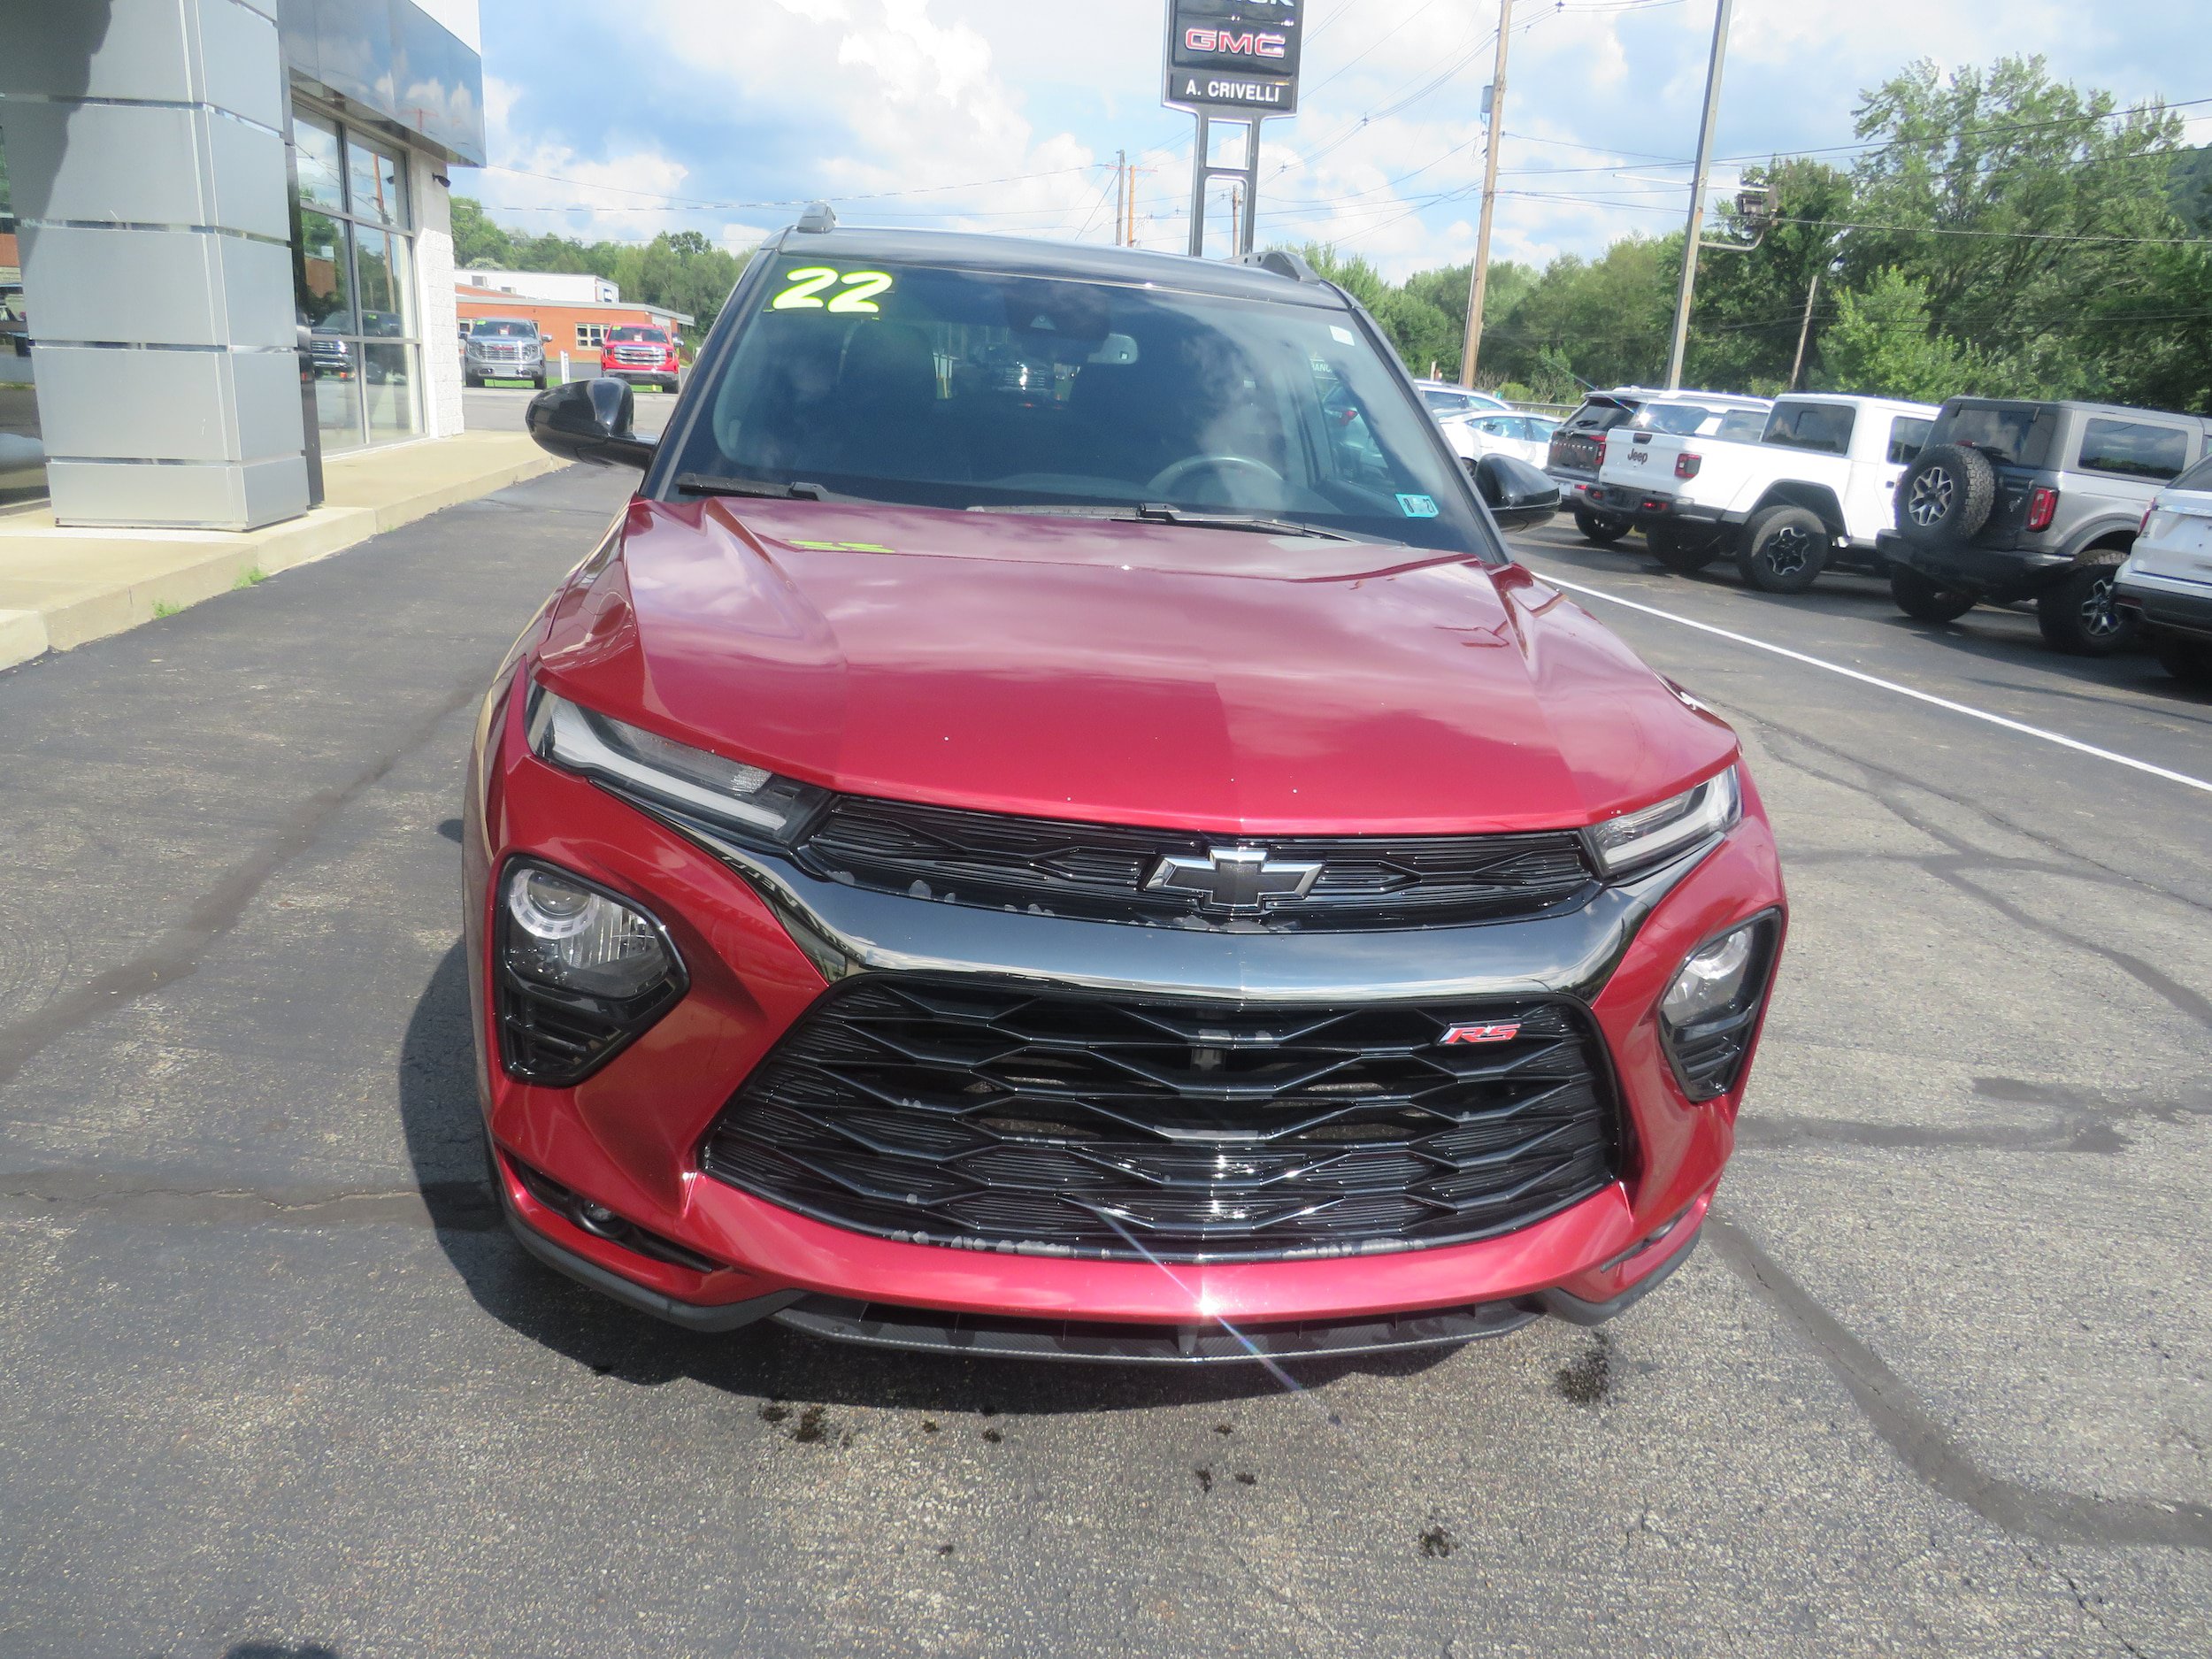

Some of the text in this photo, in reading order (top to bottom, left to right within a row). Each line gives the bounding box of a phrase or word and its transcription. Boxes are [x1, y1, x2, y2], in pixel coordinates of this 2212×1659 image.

[1186, 28, 1286, 58] GMC
[1186, 80, 1279, 103] A. CRIVELLI
[772, 267, 893, 312] 22
[1627, 448, 1648, 465] Jeep
[1441, 1024, 1521, 1044] RS
